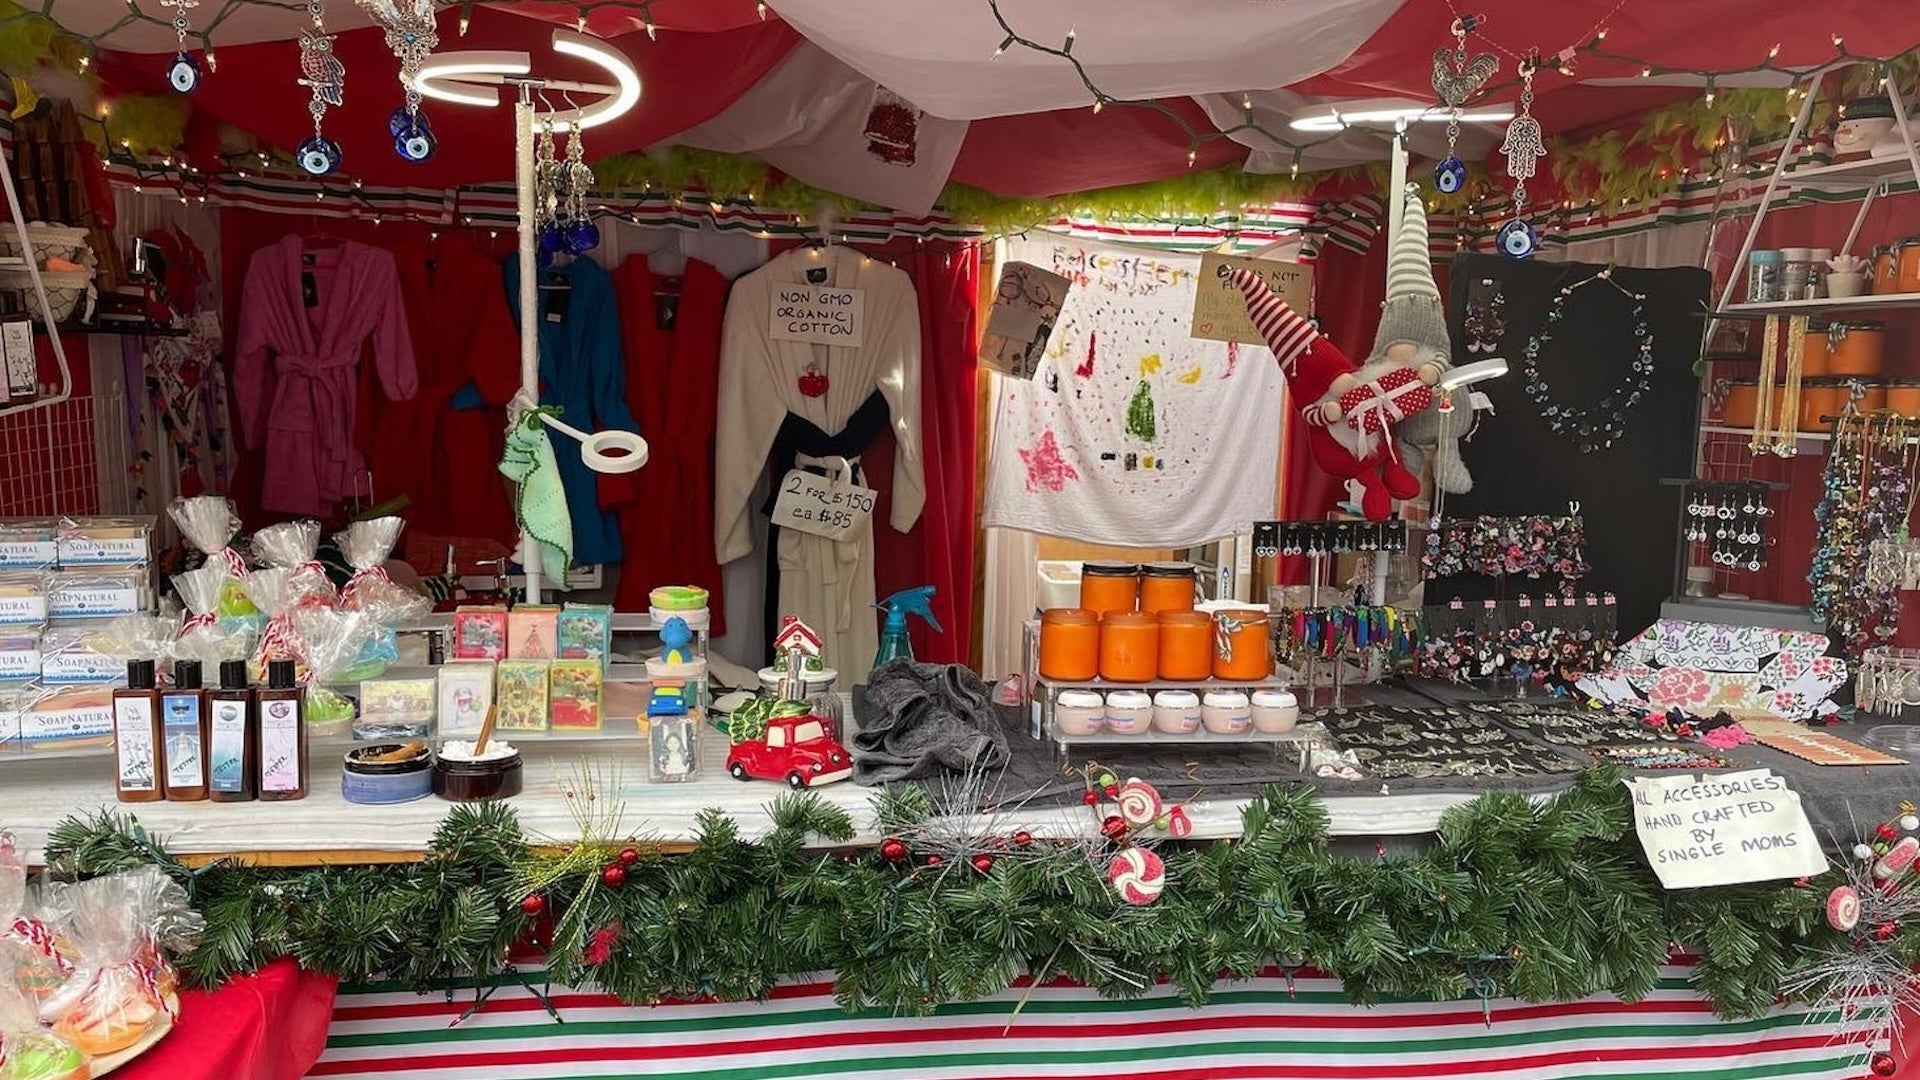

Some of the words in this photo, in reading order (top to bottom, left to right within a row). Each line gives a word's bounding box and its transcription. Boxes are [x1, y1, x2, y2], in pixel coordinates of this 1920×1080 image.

[1271, 271, 1301, 282] NOT
[780, 290, 810, 303] NON
[819, 293, 853, 305] GMO
[777, 307, 847, 322] ORGANIC
[788, 313, 853, 335] COTTON
[786, 476, 802, 495] 2
[805, 487, 830, 505] FOR
[792, 506, 812, 520] ea
[818, 508, 853, 529] $85
[1643, 813, 1682, 830] HAND
[1692, 800, 1775, 825] CRAFTED
[1689, 828, 1715, 843] BY
[1657, 842, 1725, 864] SINGLE
[1741, 832, 1797, 853] MOMS
